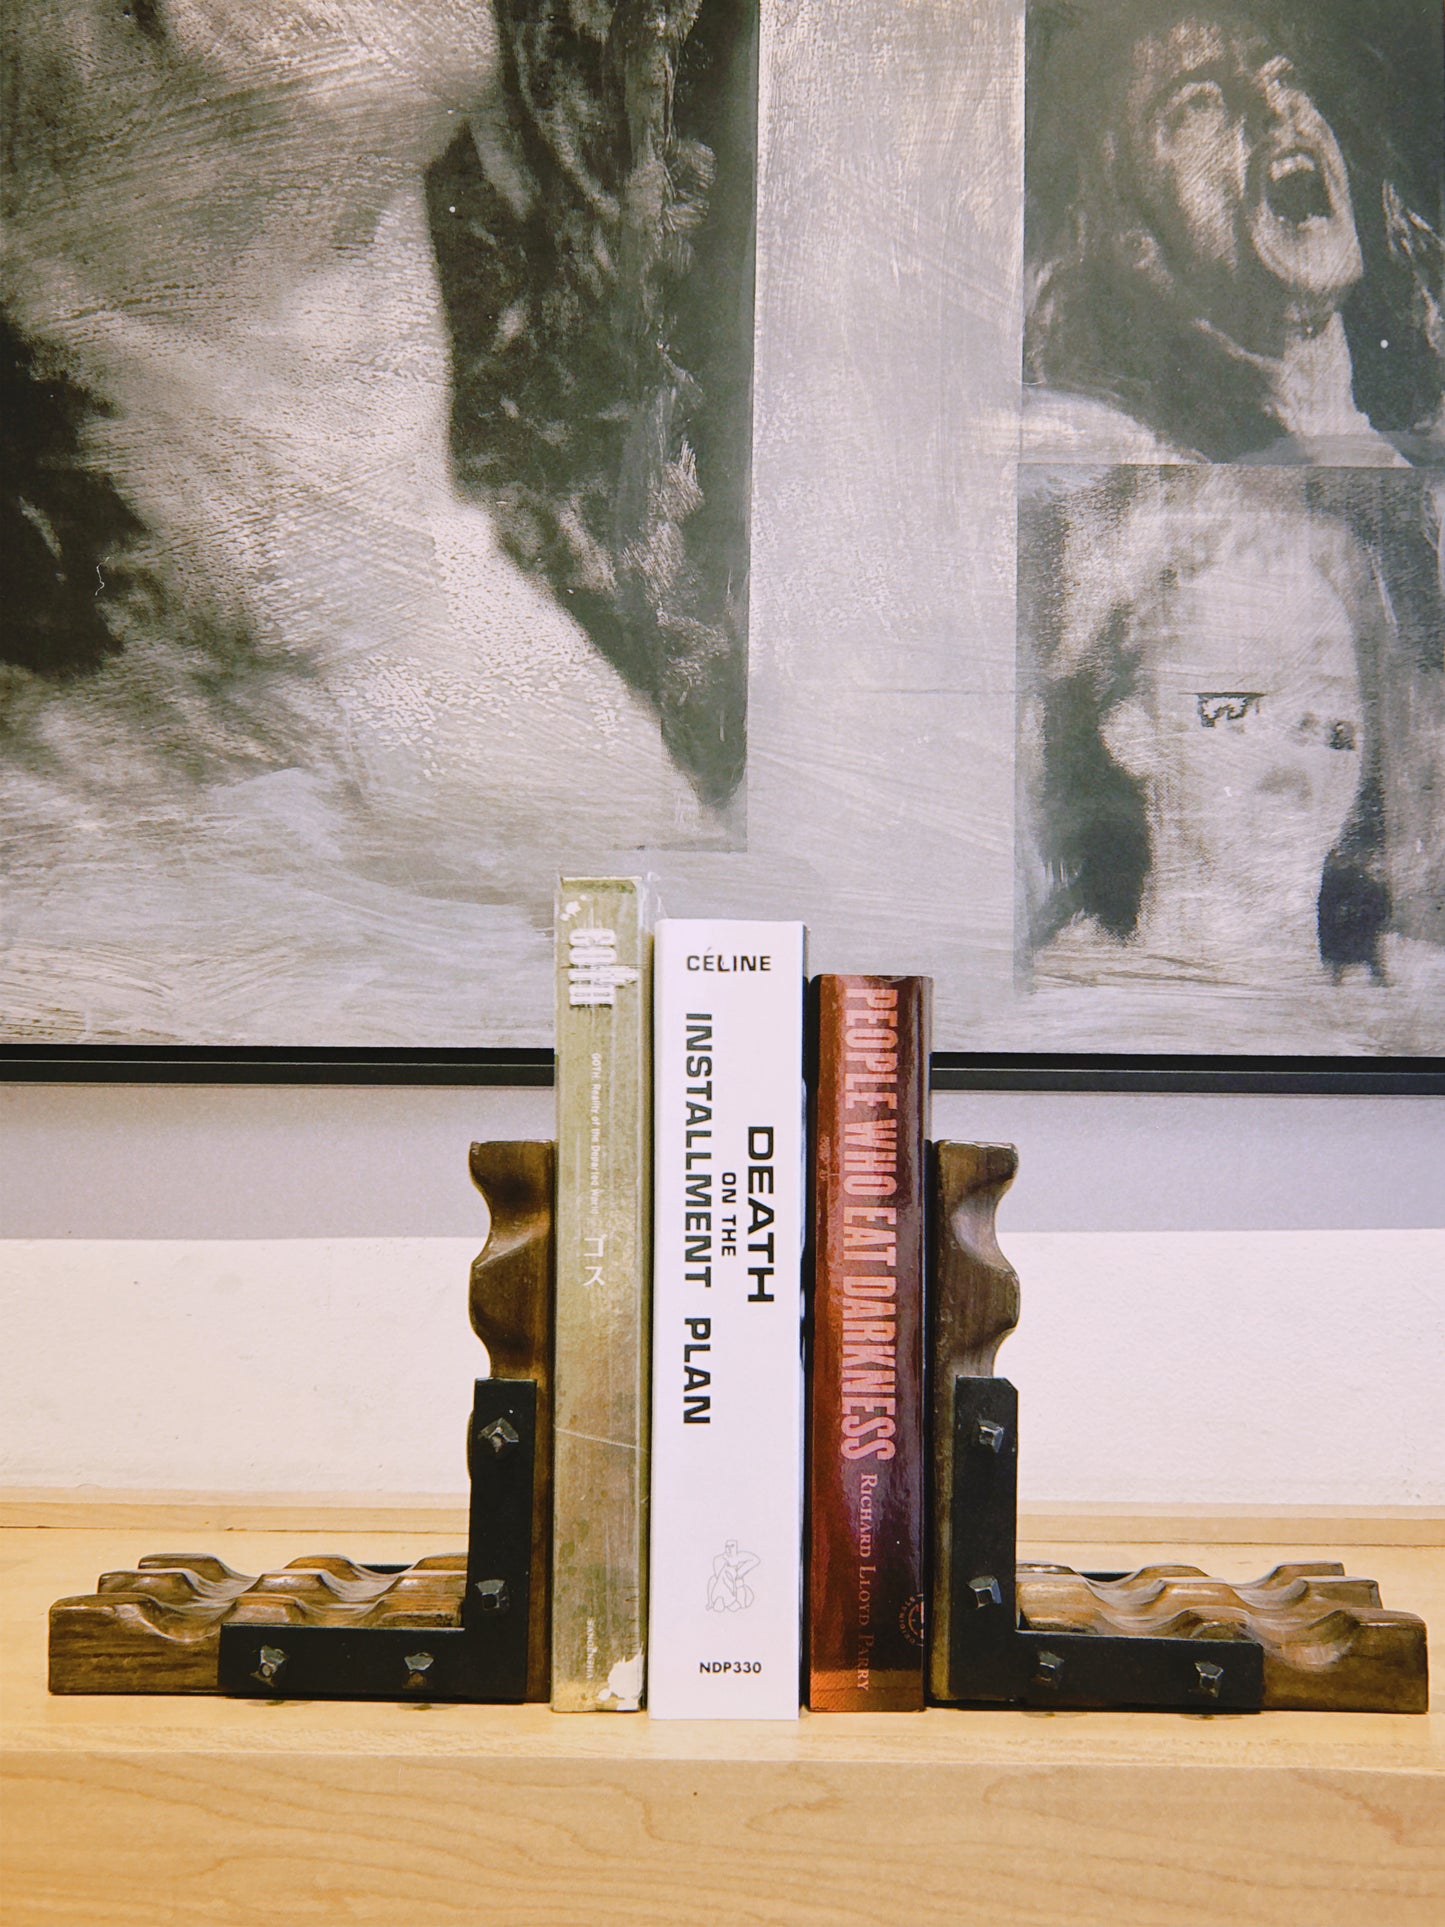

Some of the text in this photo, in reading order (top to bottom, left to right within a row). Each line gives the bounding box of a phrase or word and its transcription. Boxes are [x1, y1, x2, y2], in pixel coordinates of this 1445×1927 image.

[592, 1116, 602, 1126] of
[592, 1128, 602, 1143] the
[684, 1014, 712, 1424] INSTALLMENT PLAN
[722, 1173, 737, 1256] ON THE
[747, 1126, 775, 1303] DEATH
[841, 988, 898, 1460] PEOPLE WHO EAT DARKNESS
[856, 1473, 879, 1691] RICHARD LLOYD PARRY
[699, 1661, 762, 1674] NDP330
